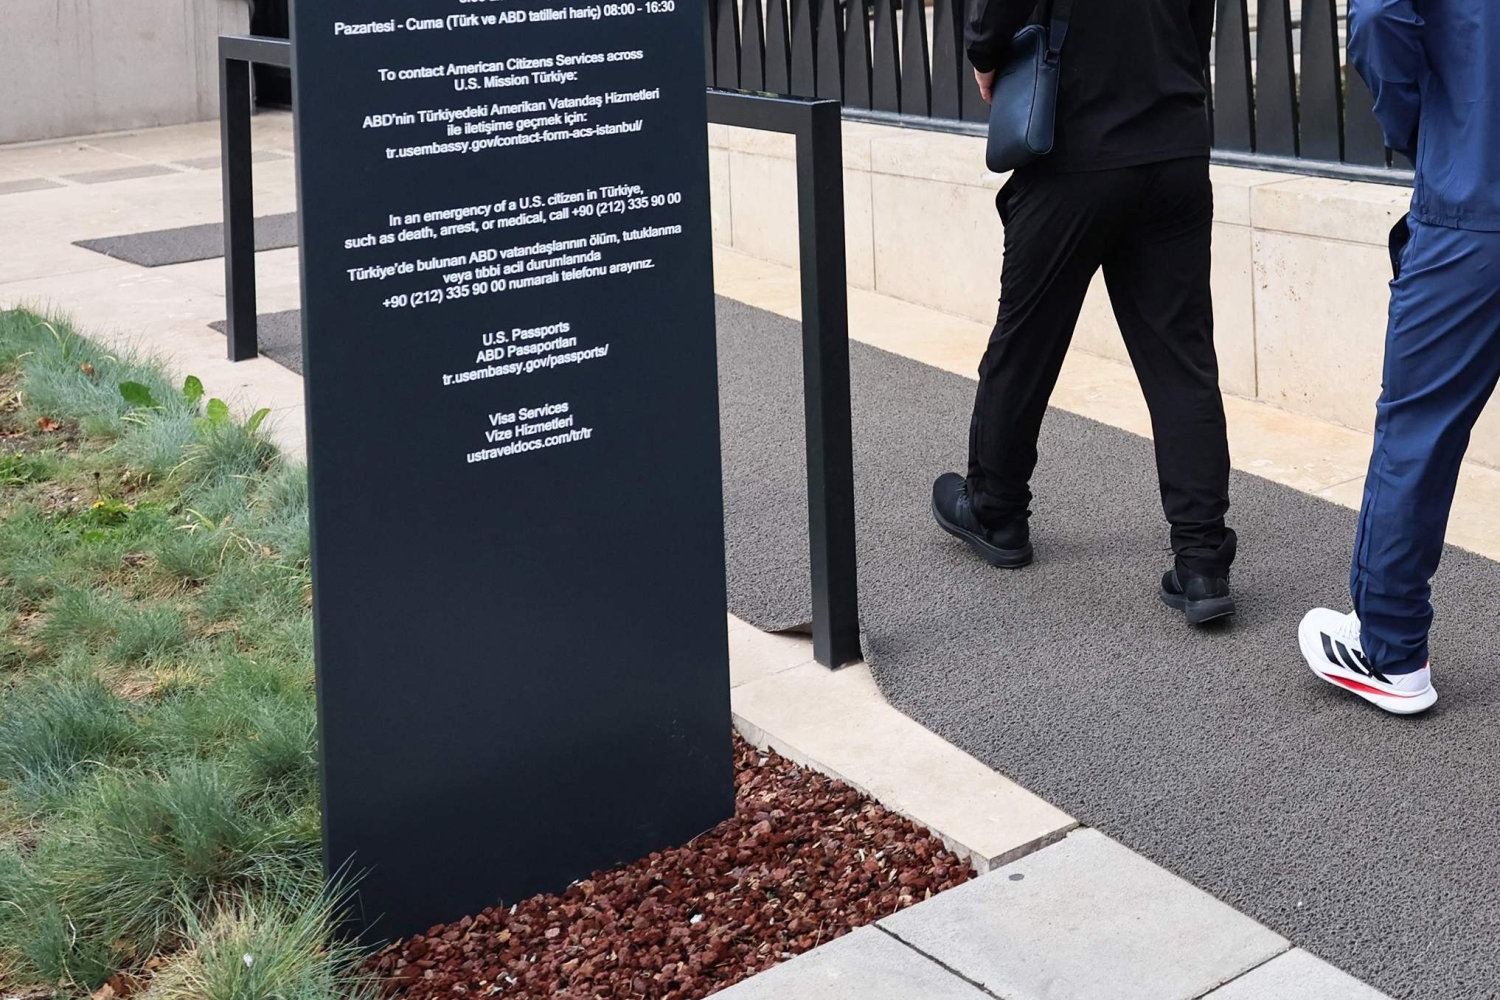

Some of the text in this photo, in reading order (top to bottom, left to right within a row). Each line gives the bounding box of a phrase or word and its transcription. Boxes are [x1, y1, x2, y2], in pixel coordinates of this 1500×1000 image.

[334, 0, 674, 34] Pazartesi Cuma (Türk ve ABD tatilleri hariç) 08:00 16:30
[378, 50, 643, 80] To contact American Citizens Services across
[454, 70, 577, 90] U.S. Mission Türkiye:
[417, 104, 487, 122] Türkiyedeki
[490, 100, 546, 115] Amerikan
[548, 94, 602, 108] Vatandaş
[605, 87, 658, 103] Hizmetleri
[386, 119, 642, 158] tr.usembassy.gov/contact-form-acs-istanbul/
[447, 111, 586, 135] ile iletişime geçmek için:
[344, 192, 680, 248] such as death, arrest, or medical, call +90 (212) 335 90 00
[389, 184, 643, 226] In an emergency of a U.S. citizen in Türkiye,
[416, 255, 466, 270] bulunan
[469, 249, 497, 263] ABD
[589, 233, 619, 245] ölüm,
[622, 224, 681, 240] tutuklanma
[382, 259, 654, 307] +90 (212) 335 90 00 numaralı telefonu arayınız.
[442, 271, 472, 284] veya
[474, 263, 500, 278] tıbbi
[503, 260, 523, 274] acil
[482, 322, 569, 345] U.S. Passports
[442, 343, 608, 385] tr.usembassy.gov/passports/
[476, 347, 504, 362] ABD
[485, 414, 572, 442] Vize Hizmetleri
[488, 402, 568, 425] Visa Services
[467, 427, 592, 462] ustraveldocs.com/tr/tr
